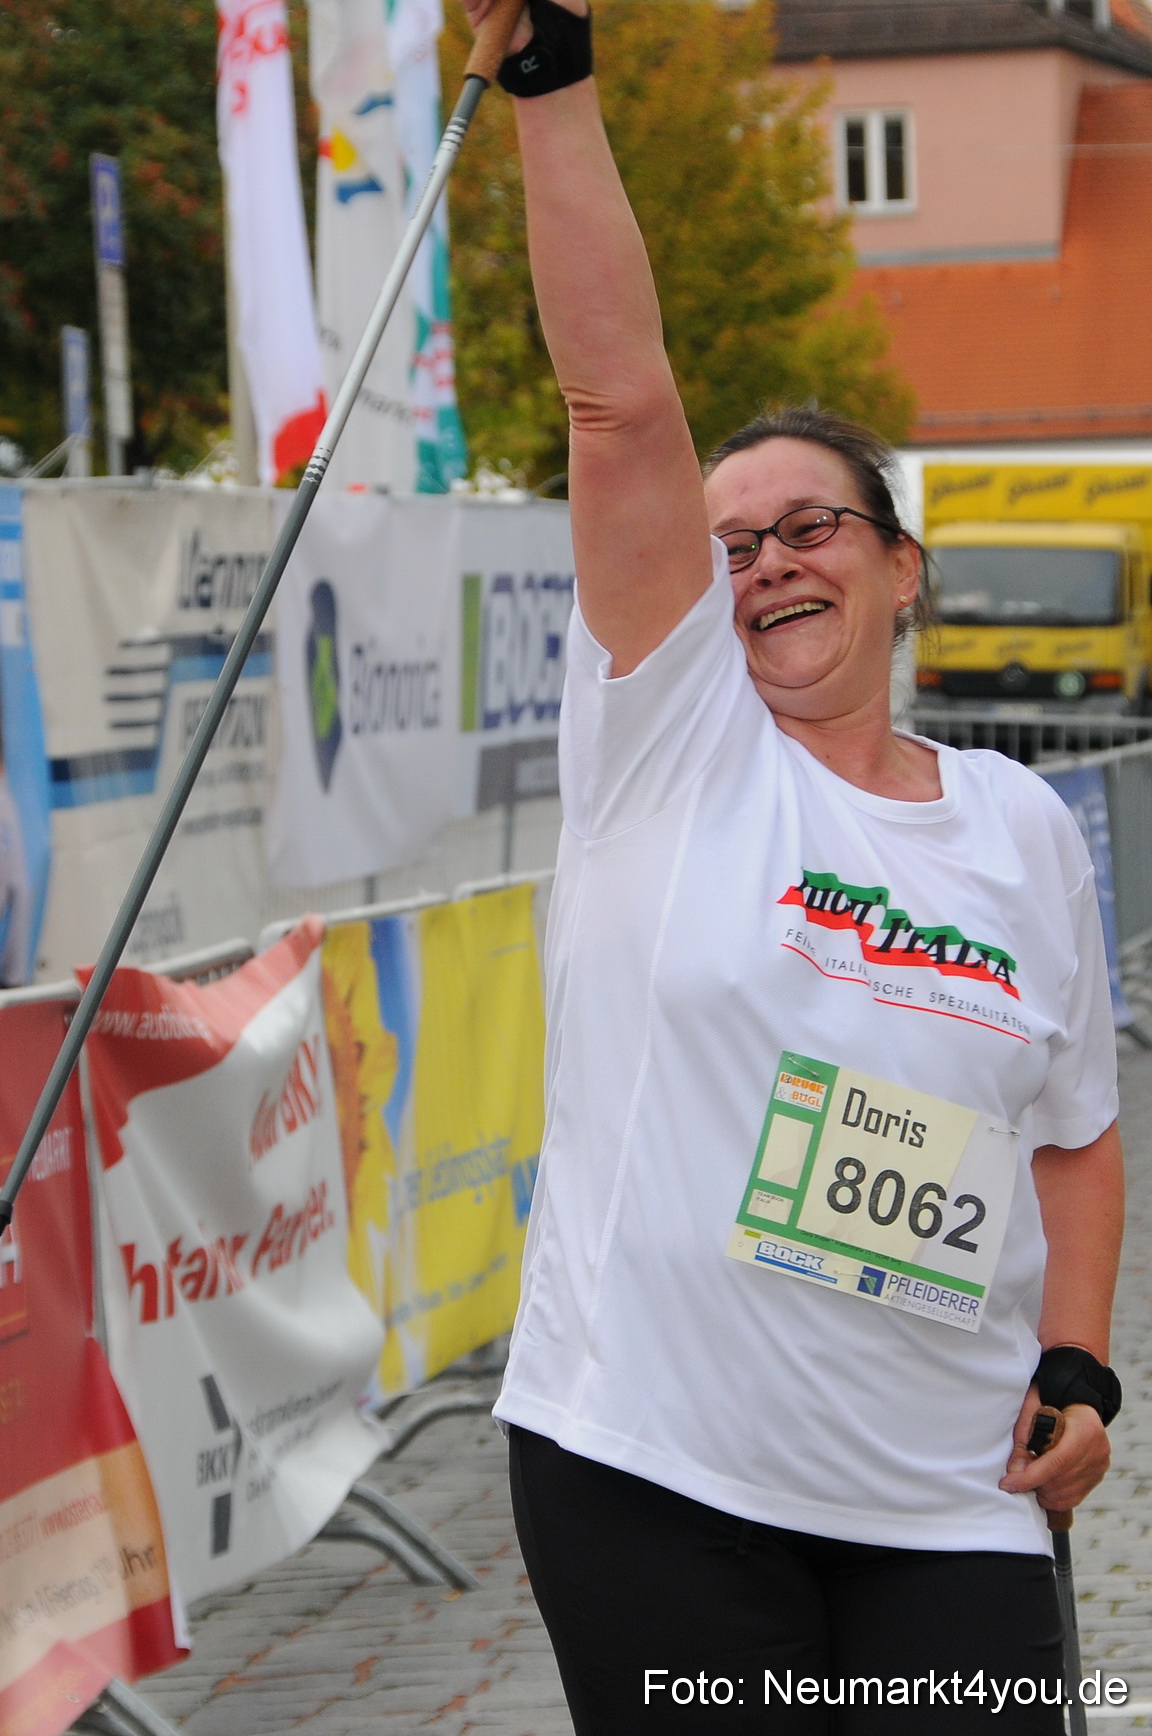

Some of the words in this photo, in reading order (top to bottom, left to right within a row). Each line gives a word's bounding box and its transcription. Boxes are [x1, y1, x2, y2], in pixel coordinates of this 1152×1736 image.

[521, 56, 540, 73] R
[928, 991, 1032, 1035] SPEZIALITÄTEN
[791, 1091, 822, 1109] BÖGL
[841, 1087, 927, 1148] Doris
[826, 1156, 987, 1254] 8062
[757, 1241, 825, 1271] BOCK
[884, 1294, 977, 1327] AKTIENGESELLSCHAFT
[887, 1274, 980, 1317] PFLEIDERER
